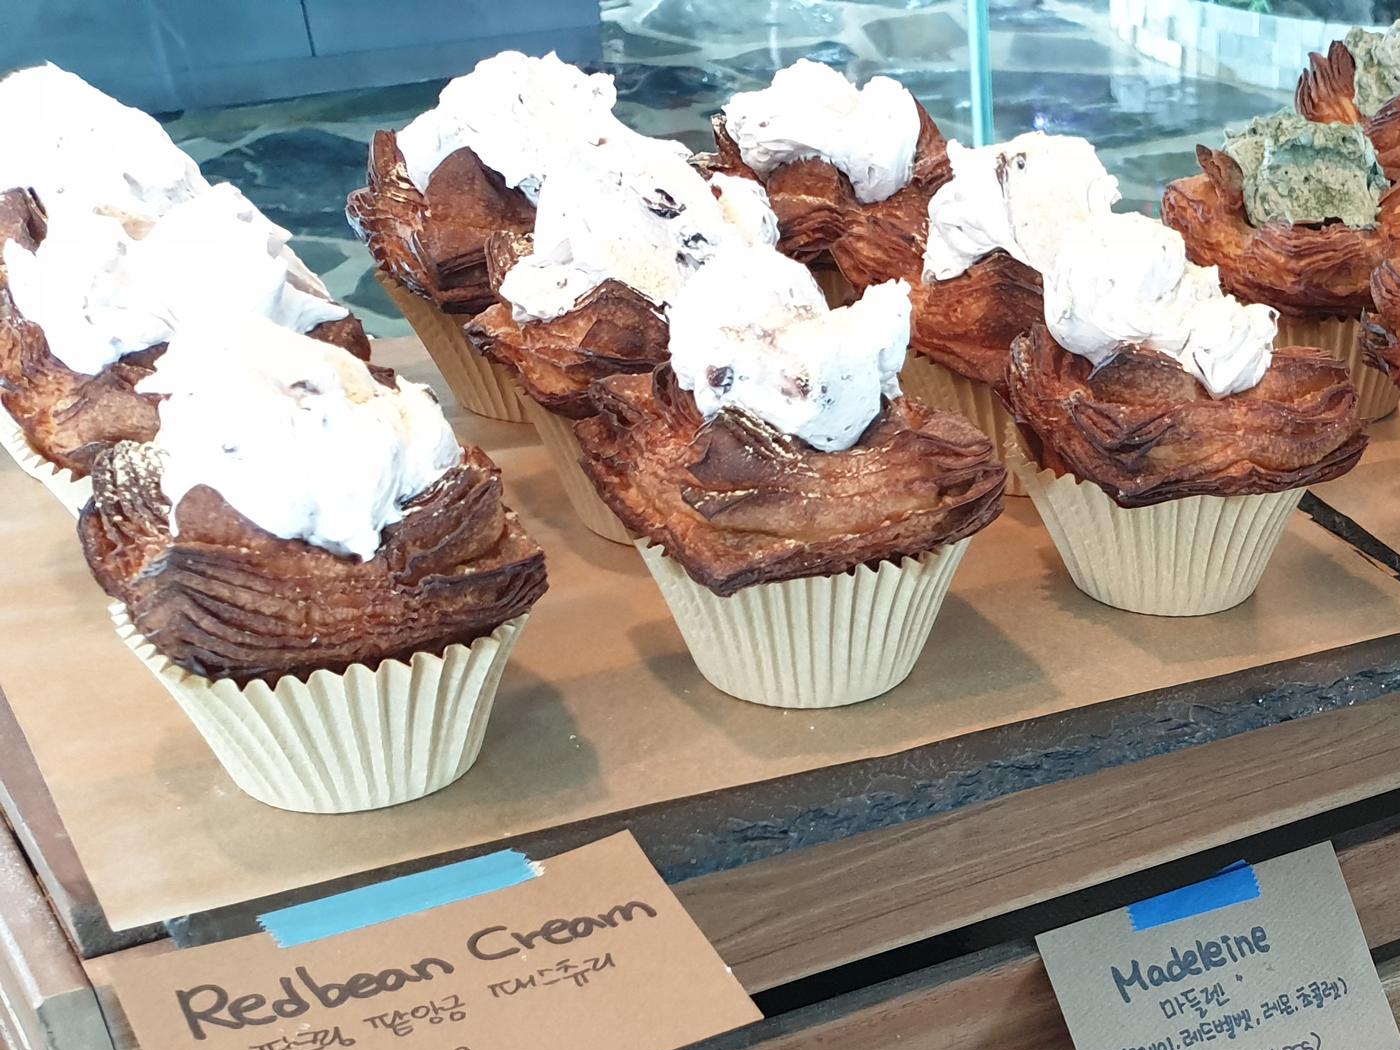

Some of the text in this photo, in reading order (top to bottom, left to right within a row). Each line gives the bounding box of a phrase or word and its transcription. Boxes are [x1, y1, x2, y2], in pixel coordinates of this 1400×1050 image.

[175, 900, 658, 1041] Redbean Cream
[1110, 925, 1272, 1004] Madeleine
[1158, 982, 1231, 1020] 마들렌
